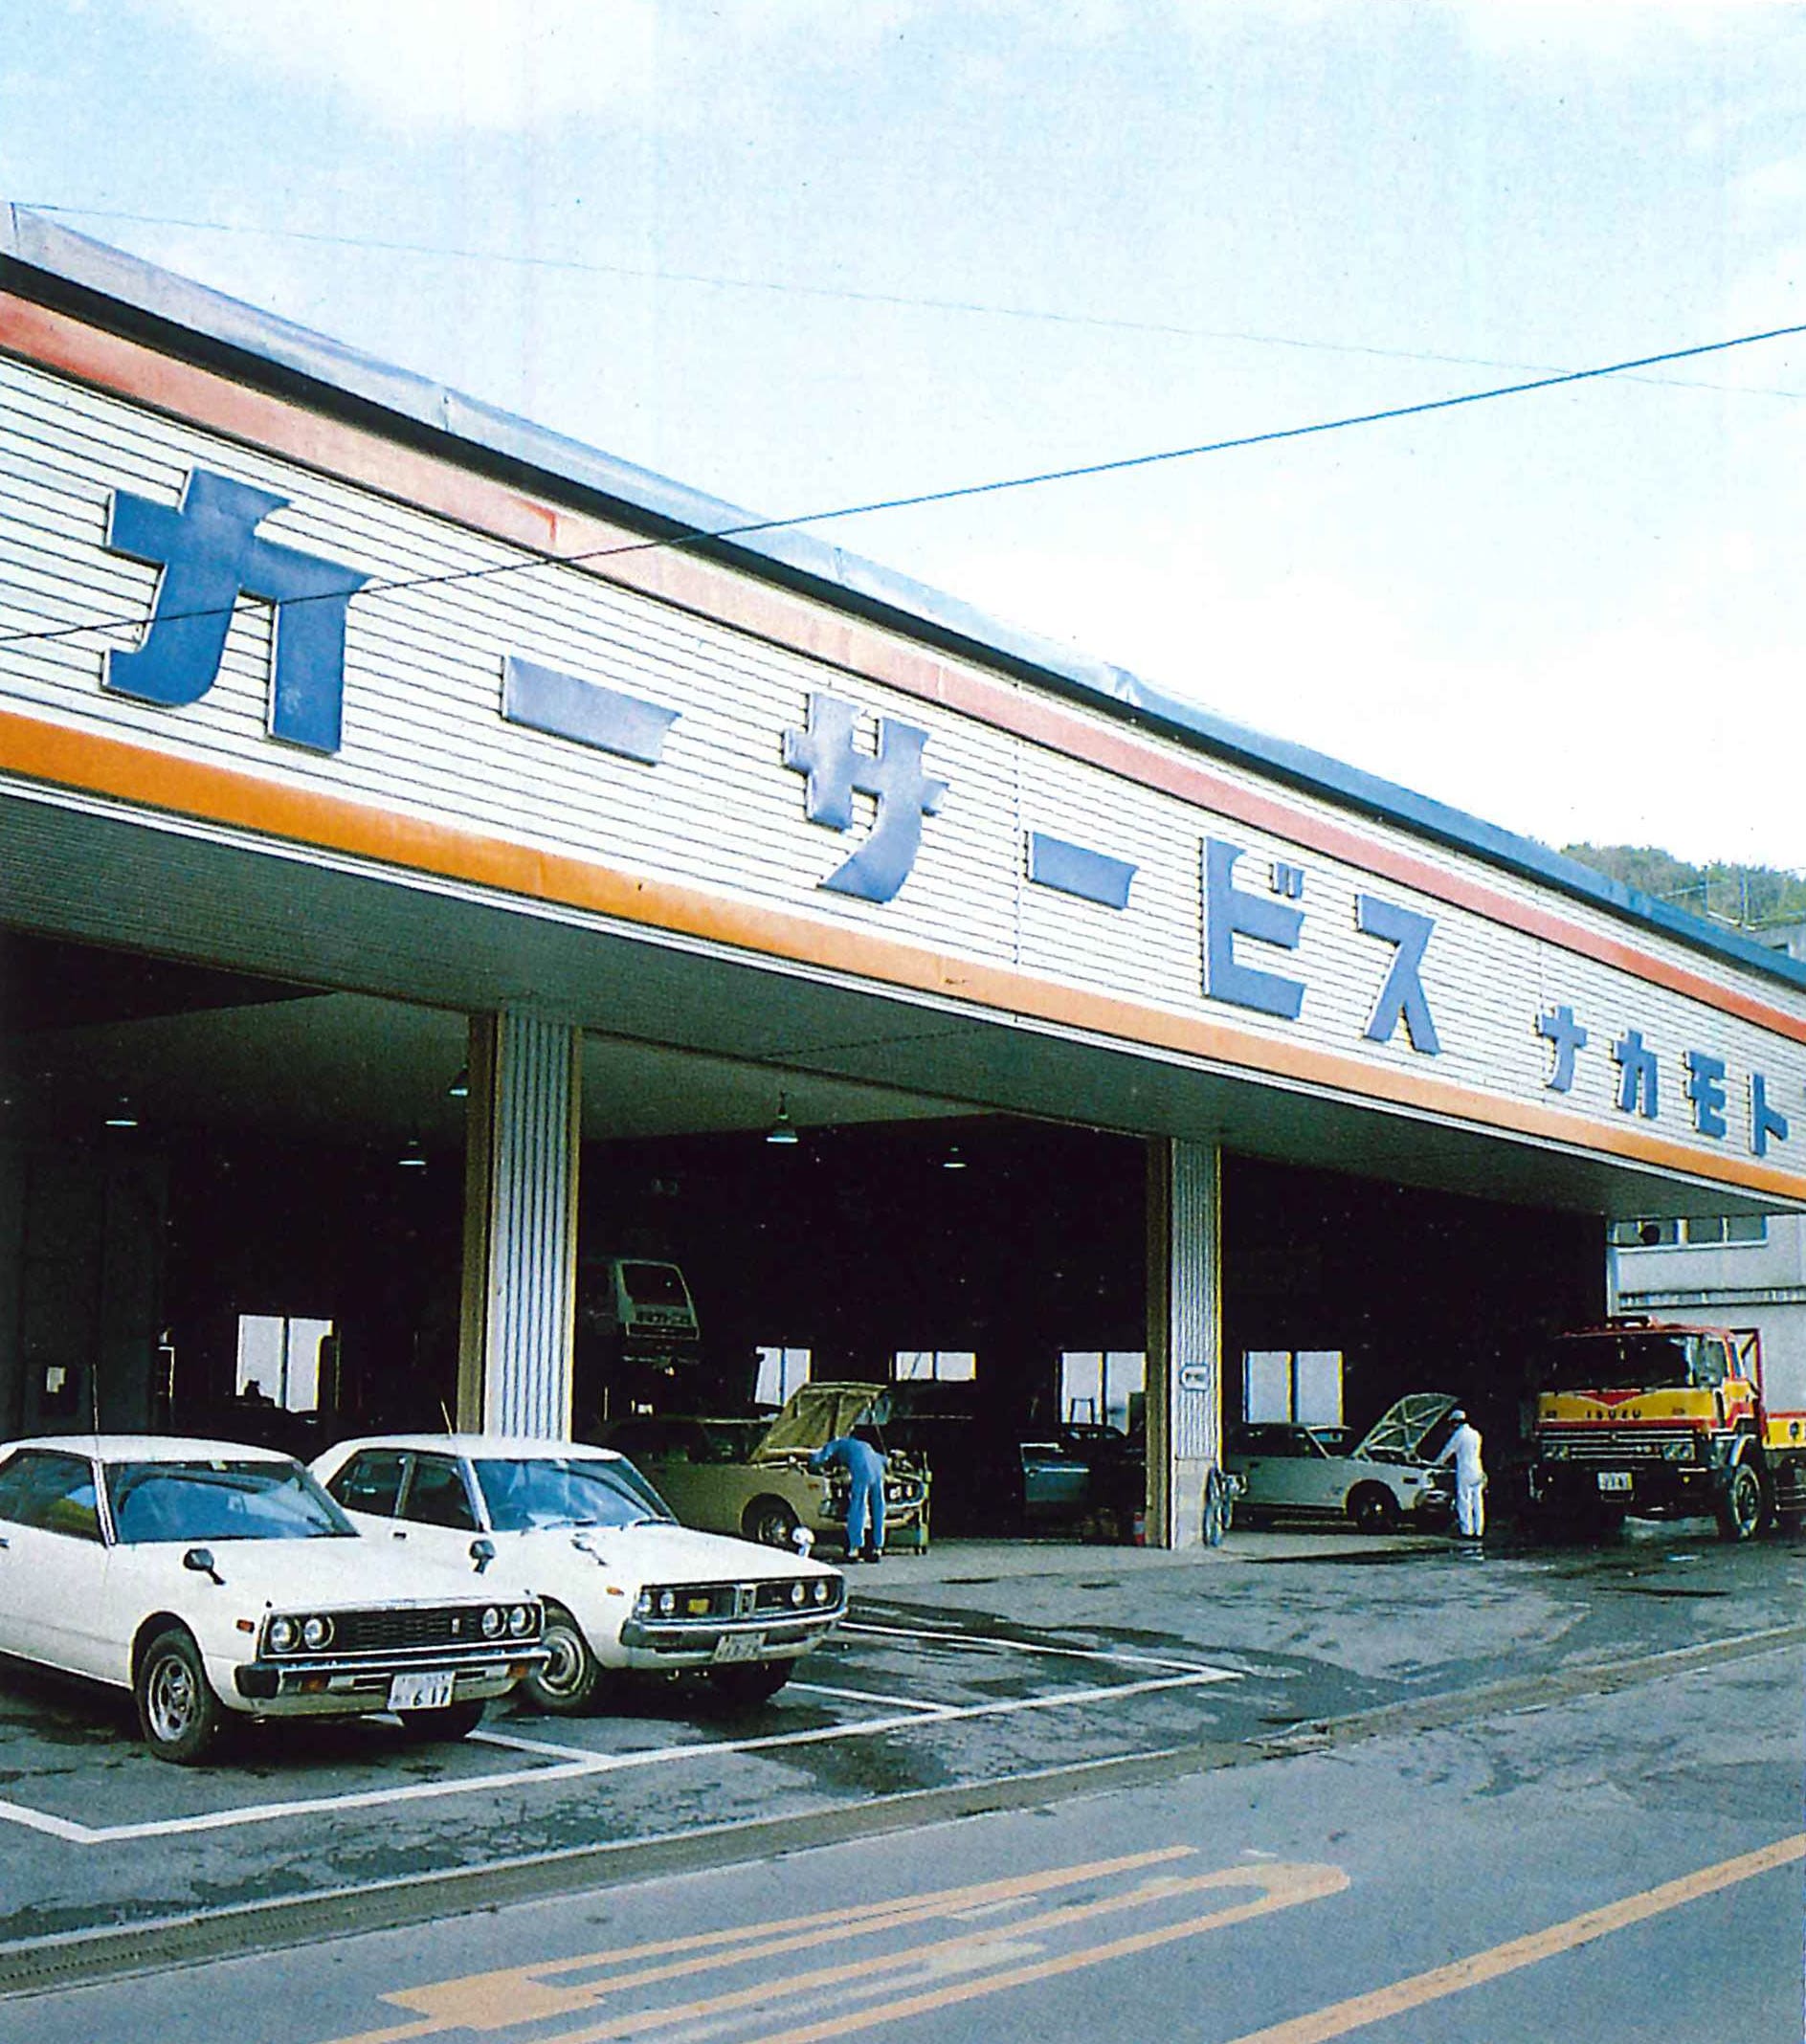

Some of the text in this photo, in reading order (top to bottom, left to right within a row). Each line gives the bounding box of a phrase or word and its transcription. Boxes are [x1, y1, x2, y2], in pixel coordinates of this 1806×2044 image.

[101, 466, 1790, 1159] カーサービス ナカモト
[1585, 1409, 1642, 1420] ISUZU
